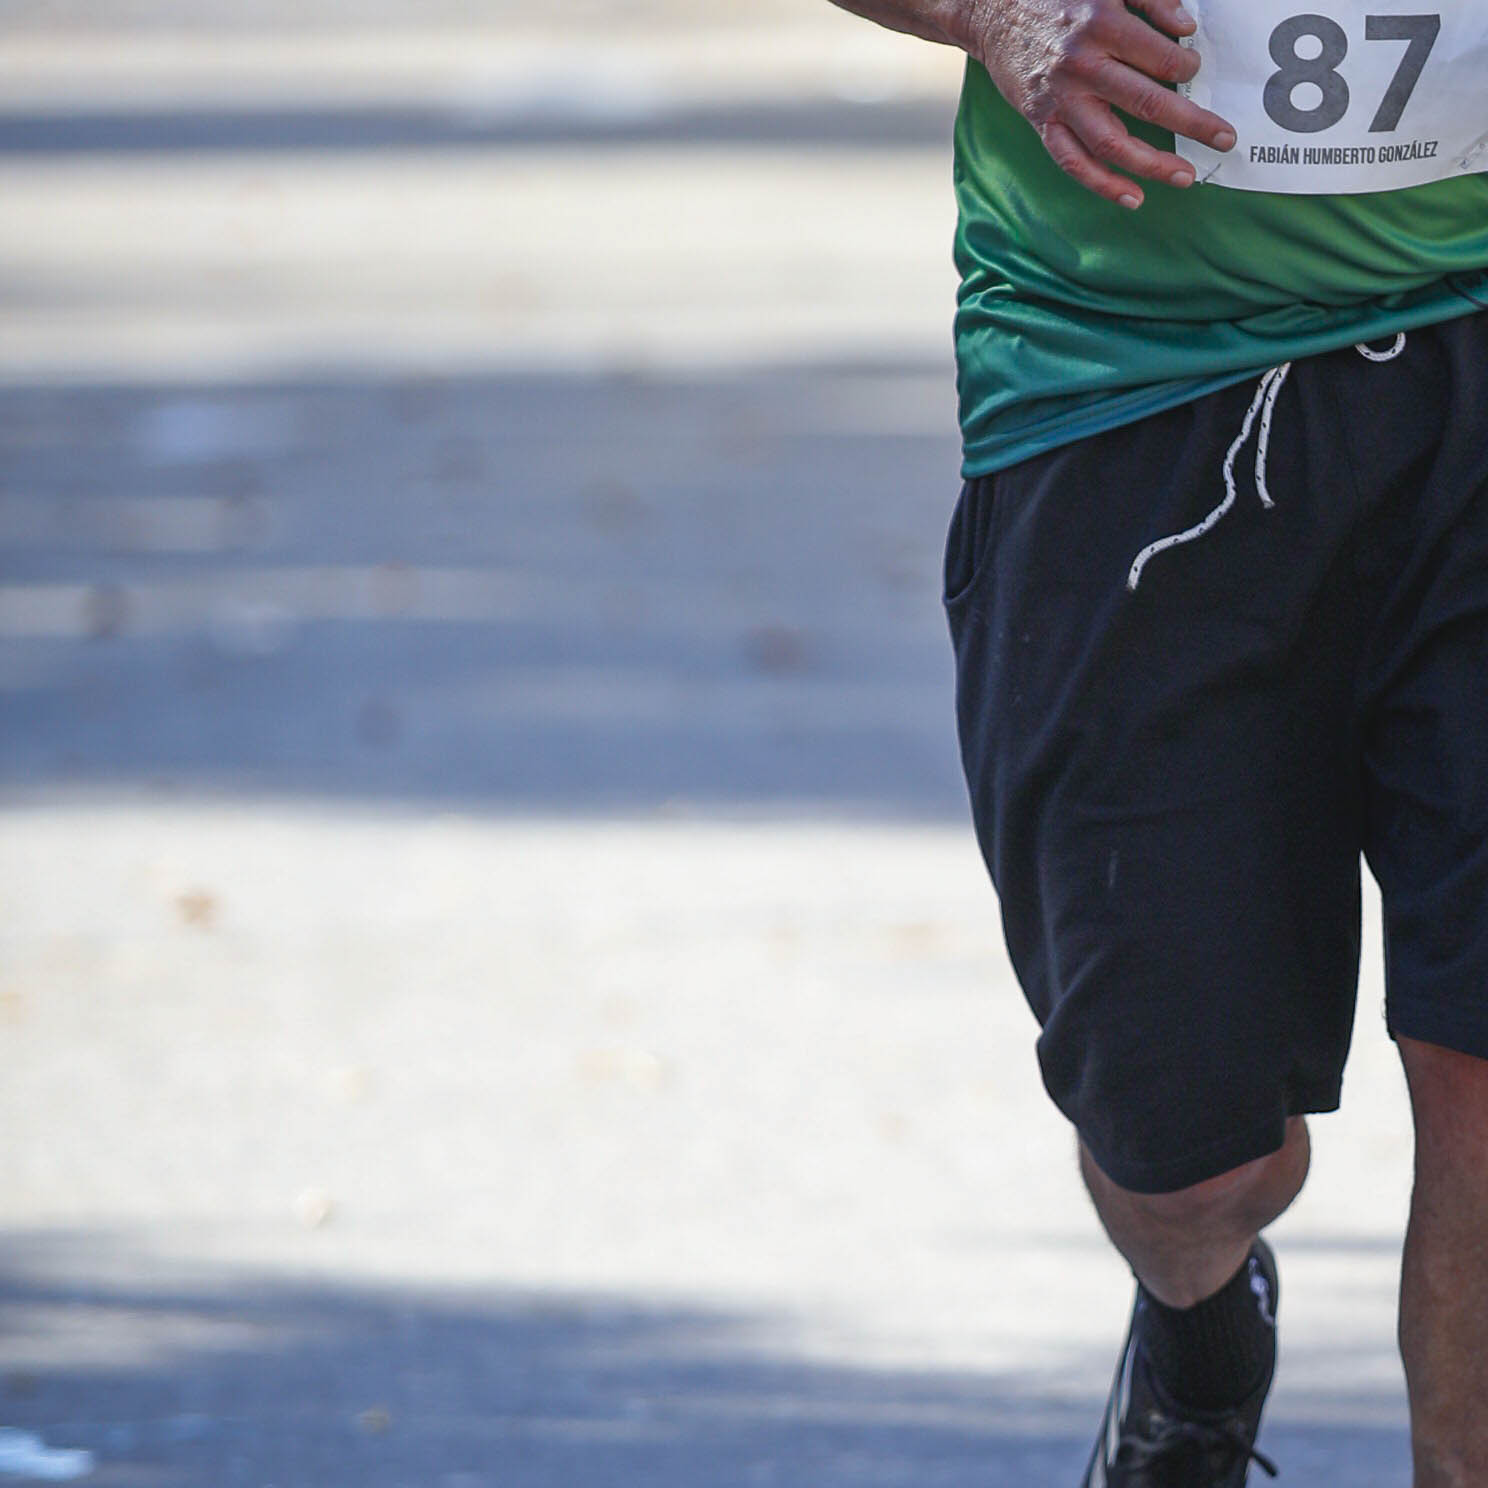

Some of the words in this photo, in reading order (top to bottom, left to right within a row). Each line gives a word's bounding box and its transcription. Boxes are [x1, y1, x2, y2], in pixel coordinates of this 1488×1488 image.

[1263, 14, 1441, 133] 87
[1250, 144, 1299, 164] FABIÁN
[1303, 147, 1375, 165] HUMBERTO
[1378, 141, 1438, 163] GONZÁLEZ
